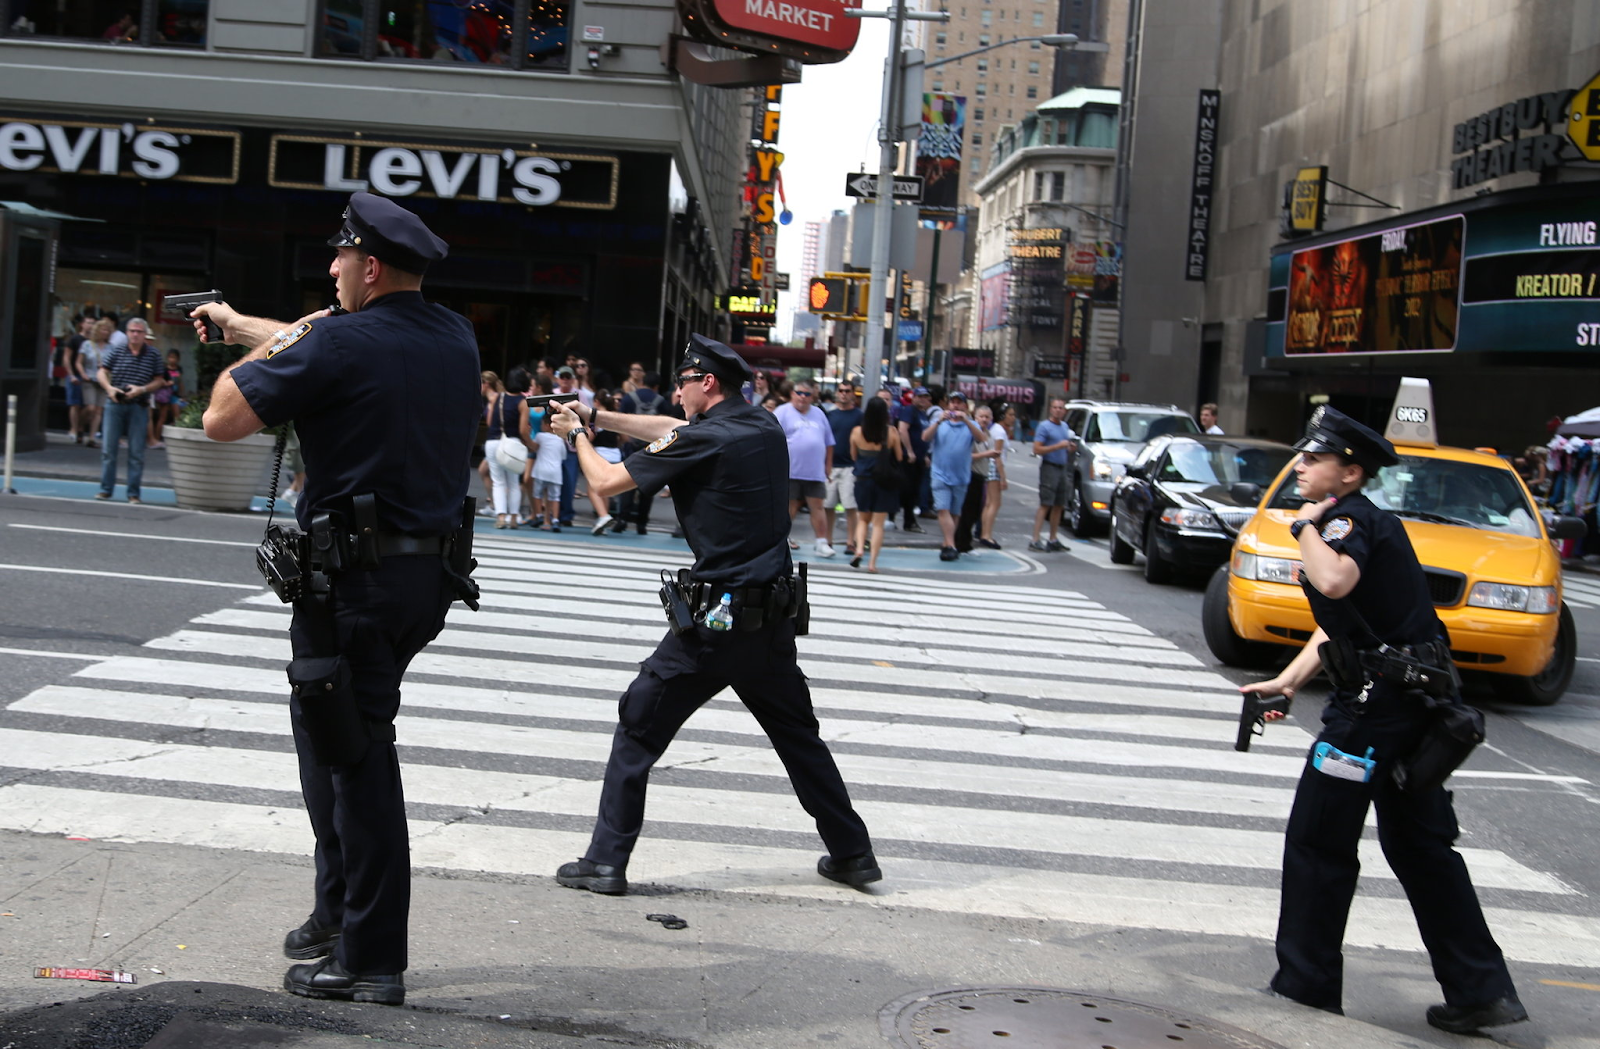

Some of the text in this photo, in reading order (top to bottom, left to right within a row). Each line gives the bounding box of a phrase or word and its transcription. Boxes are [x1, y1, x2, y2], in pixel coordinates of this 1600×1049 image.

[745, 0, 834, 32] MARKET
[1452, 134, 1564, 190] THEATER
[1189, 95, 1217, 276] MINSKOFF THEATRE
[1539, 221, 1597, 247] FLYING
[1010, 246, 1062, 258] THEATRE
[763, 246, 775, 303] DELI
[1516, 273, 1583, 297] KREATOR
[1071, 299, 1084, 339] PARK
[1576, 322, 1600, 346] ST
[958, 381, 1035, 405] MEMPHIS
[1396, 407, 1427, 423] 6K65
